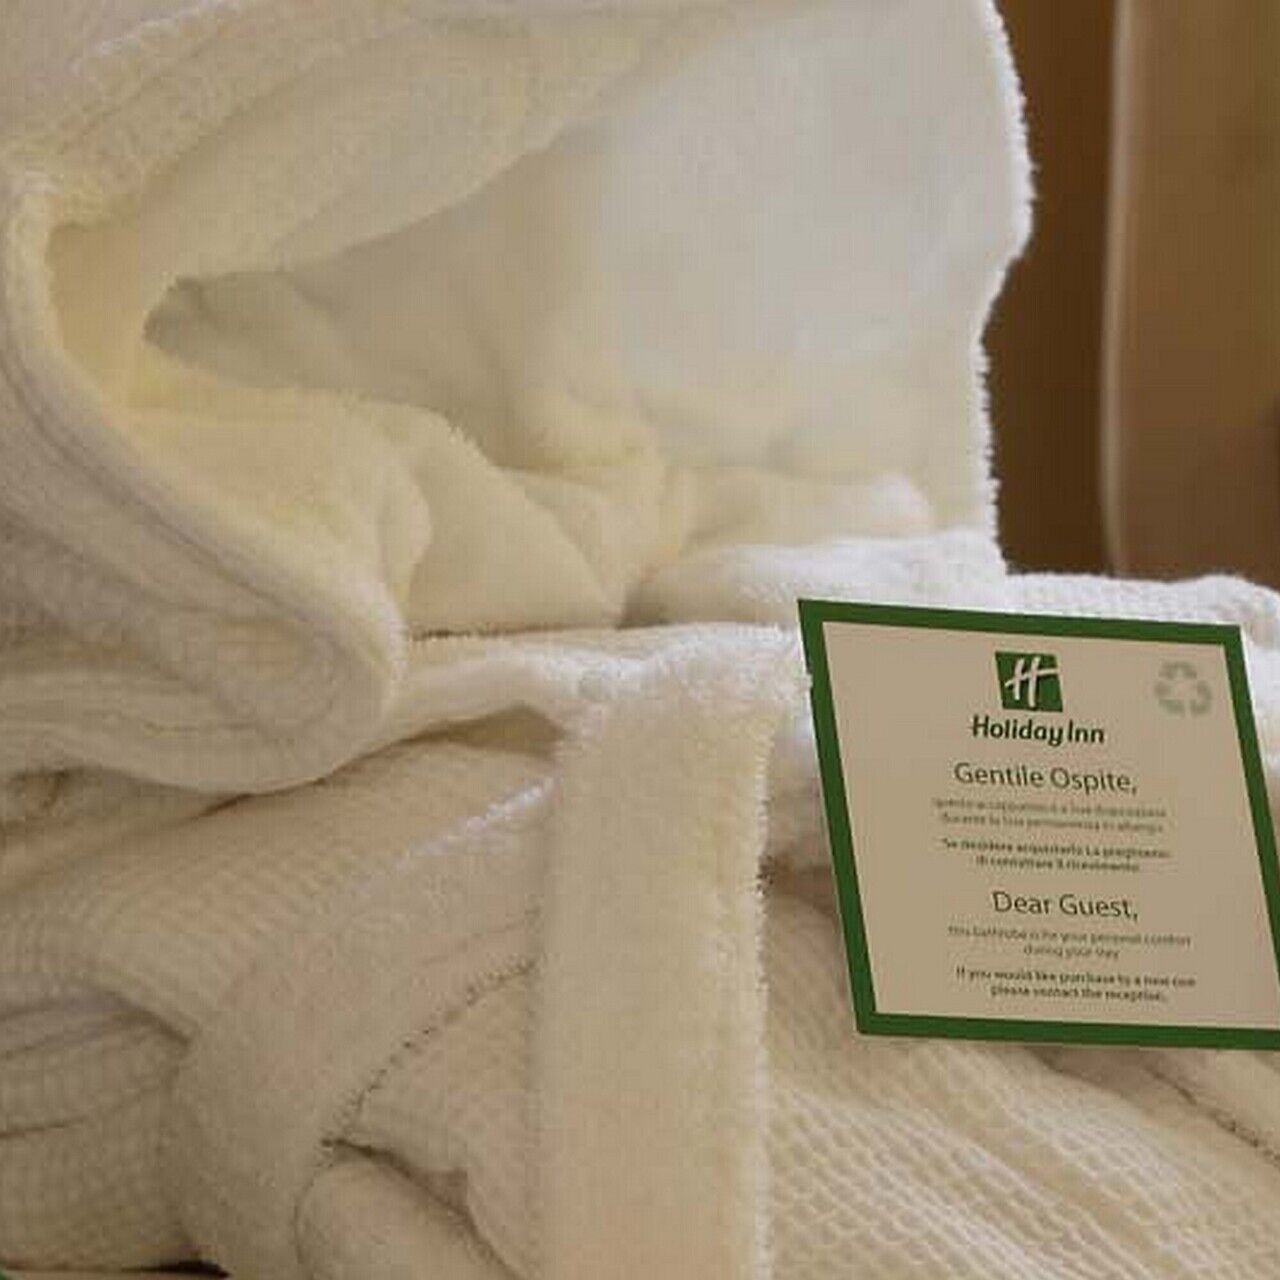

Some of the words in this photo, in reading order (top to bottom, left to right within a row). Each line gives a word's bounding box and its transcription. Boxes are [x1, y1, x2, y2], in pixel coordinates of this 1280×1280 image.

[971, 714, 1063, 746] Holiday
[1067, 719, 1105, 743] Inn
[954, 762, 1044, 788] Gentile
[1050, 767, 1137, 795] Ospite,
[992, 891, 1051, 914] Dear
[1059, 894, 1138, 922] Guest,
